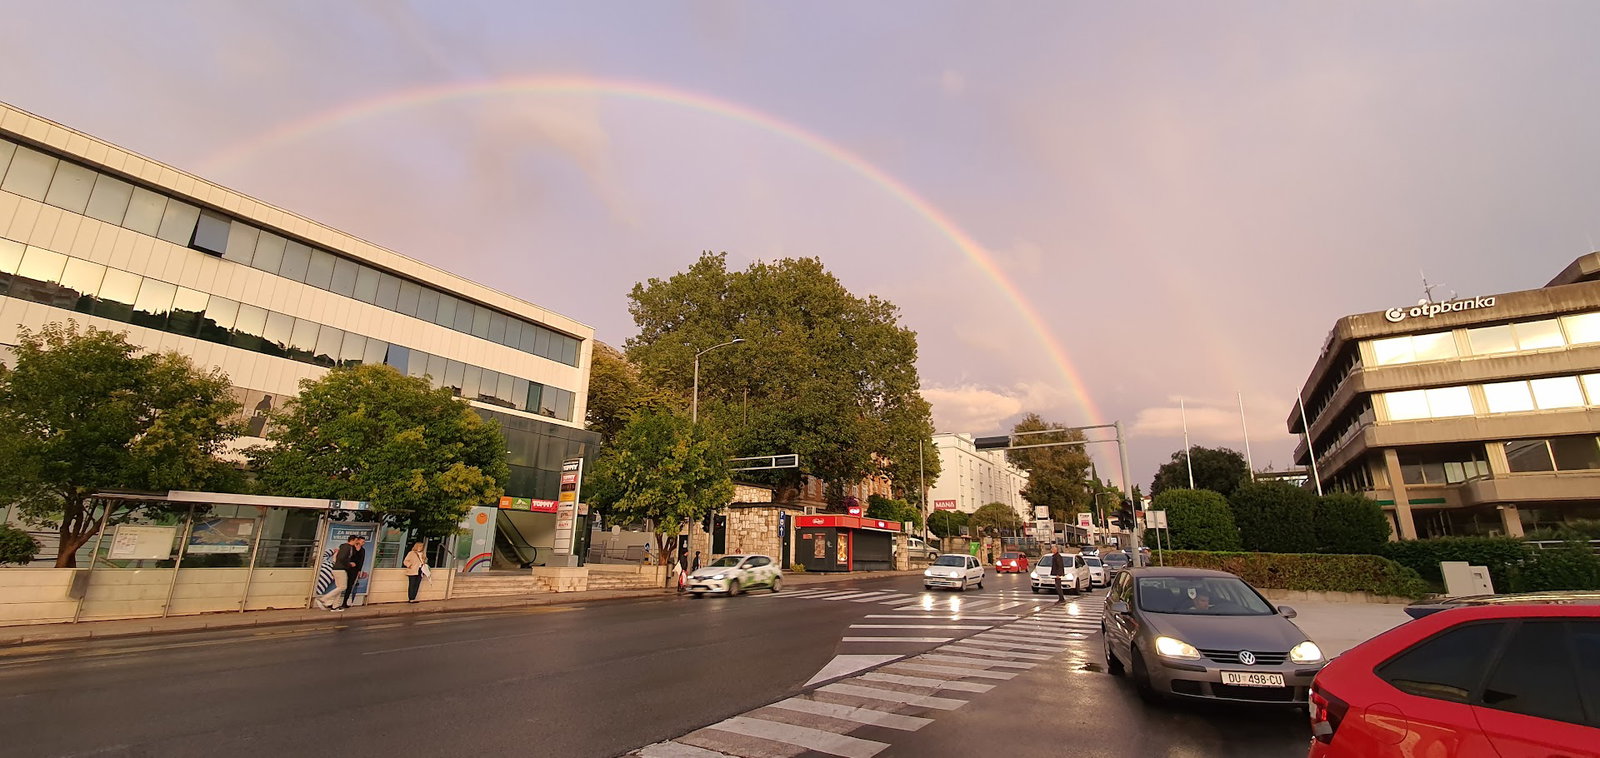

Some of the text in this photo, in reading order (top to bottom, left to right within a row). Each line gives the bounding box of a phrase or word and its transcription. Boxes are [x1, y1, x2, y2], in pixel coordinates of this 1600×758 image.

[1409, 296, 1496, 318] otpbanka
[532, 500, 554, 508] TOMMY
[1228, 673, 1241, 683] DU
